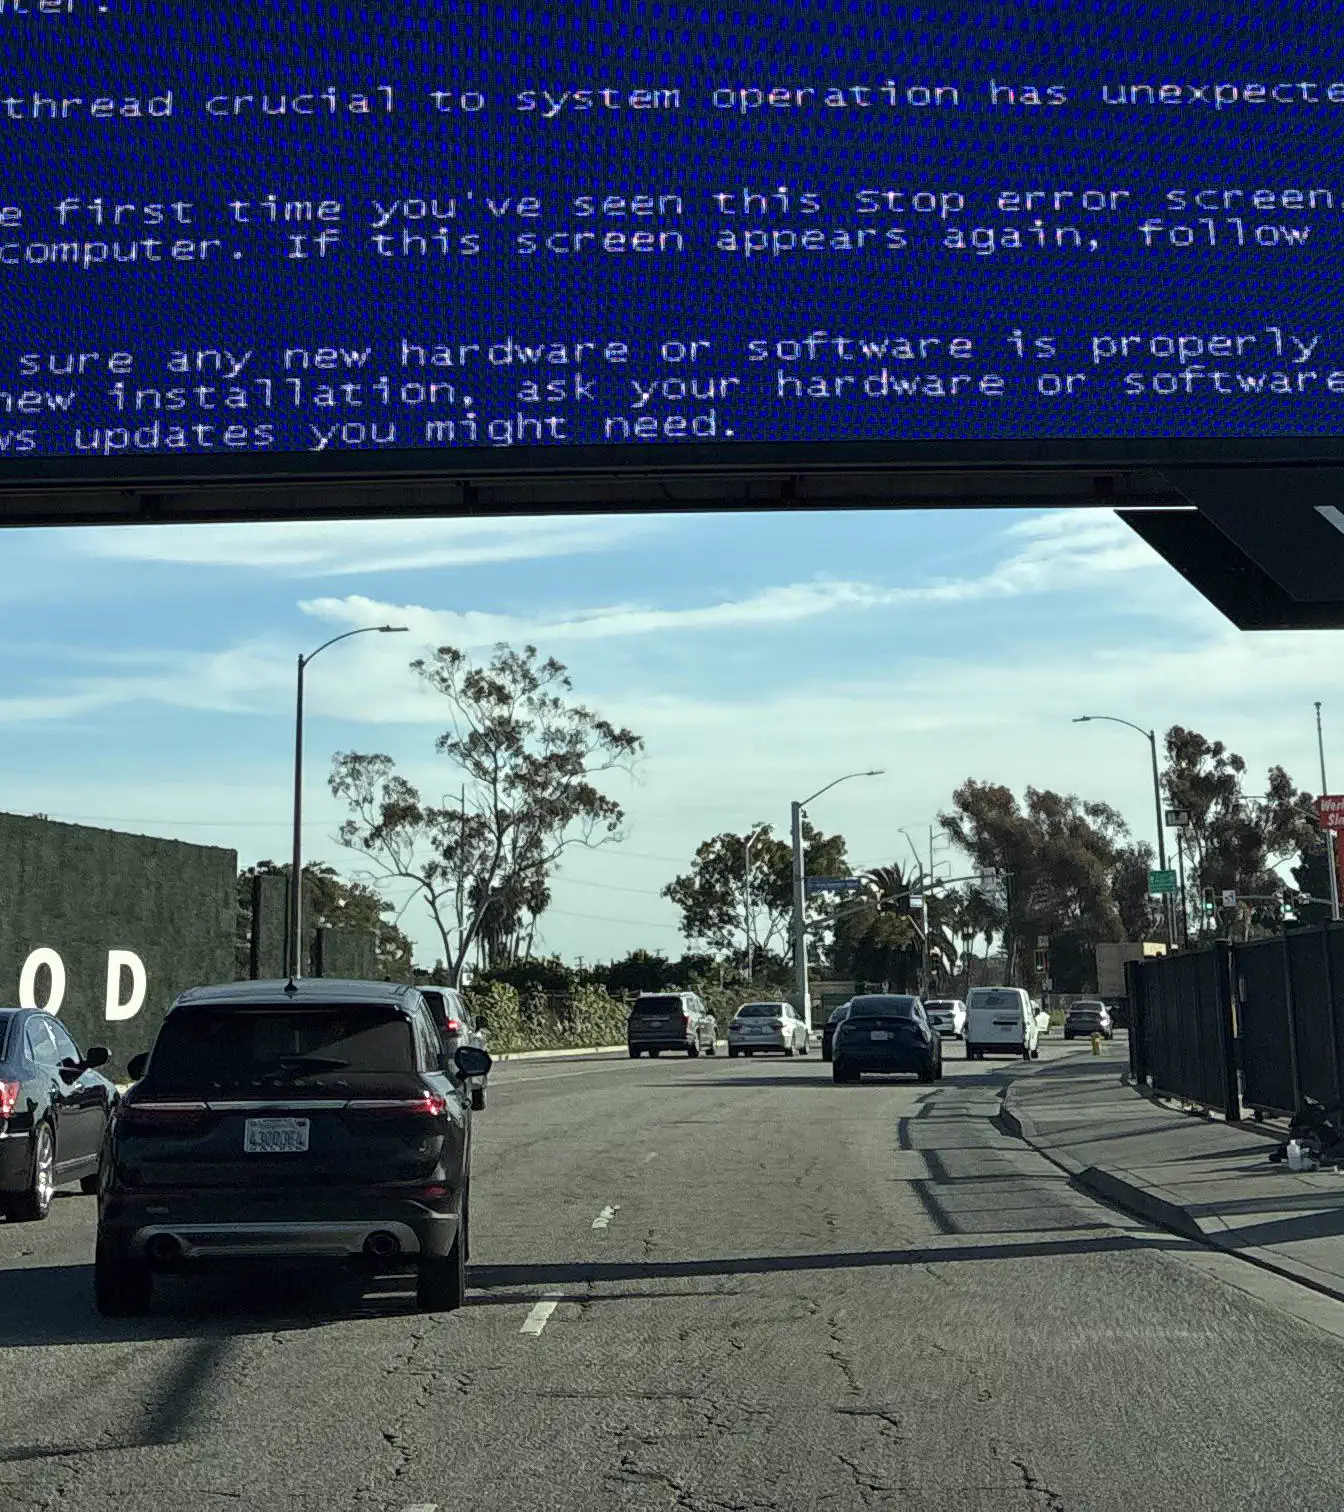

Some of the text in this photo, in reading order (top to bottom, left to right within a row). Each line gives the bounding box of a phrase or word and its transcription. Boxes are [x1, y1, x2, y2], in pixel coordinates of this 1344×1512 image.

[5, 91, 173, 119] thread
[206, 86, 393, 115] crucial
[431, 91, 485, 111] to
[517, 88, 680, 118] system
[713, 80, 959, 113] operation
[991, 79, 1068, 106] has
[57, 198, 191, 225] first
[228, 193, 342, 223] time
[371, 191, 541, 228] you've
[574, 195, 683, 216] seen
[715, 185, 820, 214] this
[997, 190, 1131, 212] error
[288, 229, 338, 259] If
[372, 227, 480, 257] this
[517, 231, 683, 253] screen
[717, 228, 907, 256] appears
[944, 218, 1098, 255] again,
[1138, 217, 1311, 247] follow
[19, 351, 133, 375] sure
[168, 350, 251, 378] any
[284, 348, 371, 370] new
[401, 338, 629, 368] hardware
[661, 340, 710, 362] or
[748, 331, 973, 365] software
[1007, 328, 1056, 358] is
[1092, 326, 1318, 368] properly
[108, 376, 476, 410] installation,
[518, 374, 593, 402] ask
[632, 377, 740, 412] your
[777, 368, 1004, 397] hardware
[1038, 373, 1086, 396] or
[75, 422, 274, 455] updates
[309, 421, 396, 452] you
[426, 412, 565, 445] might
[604, 409, 734, 438] need.
